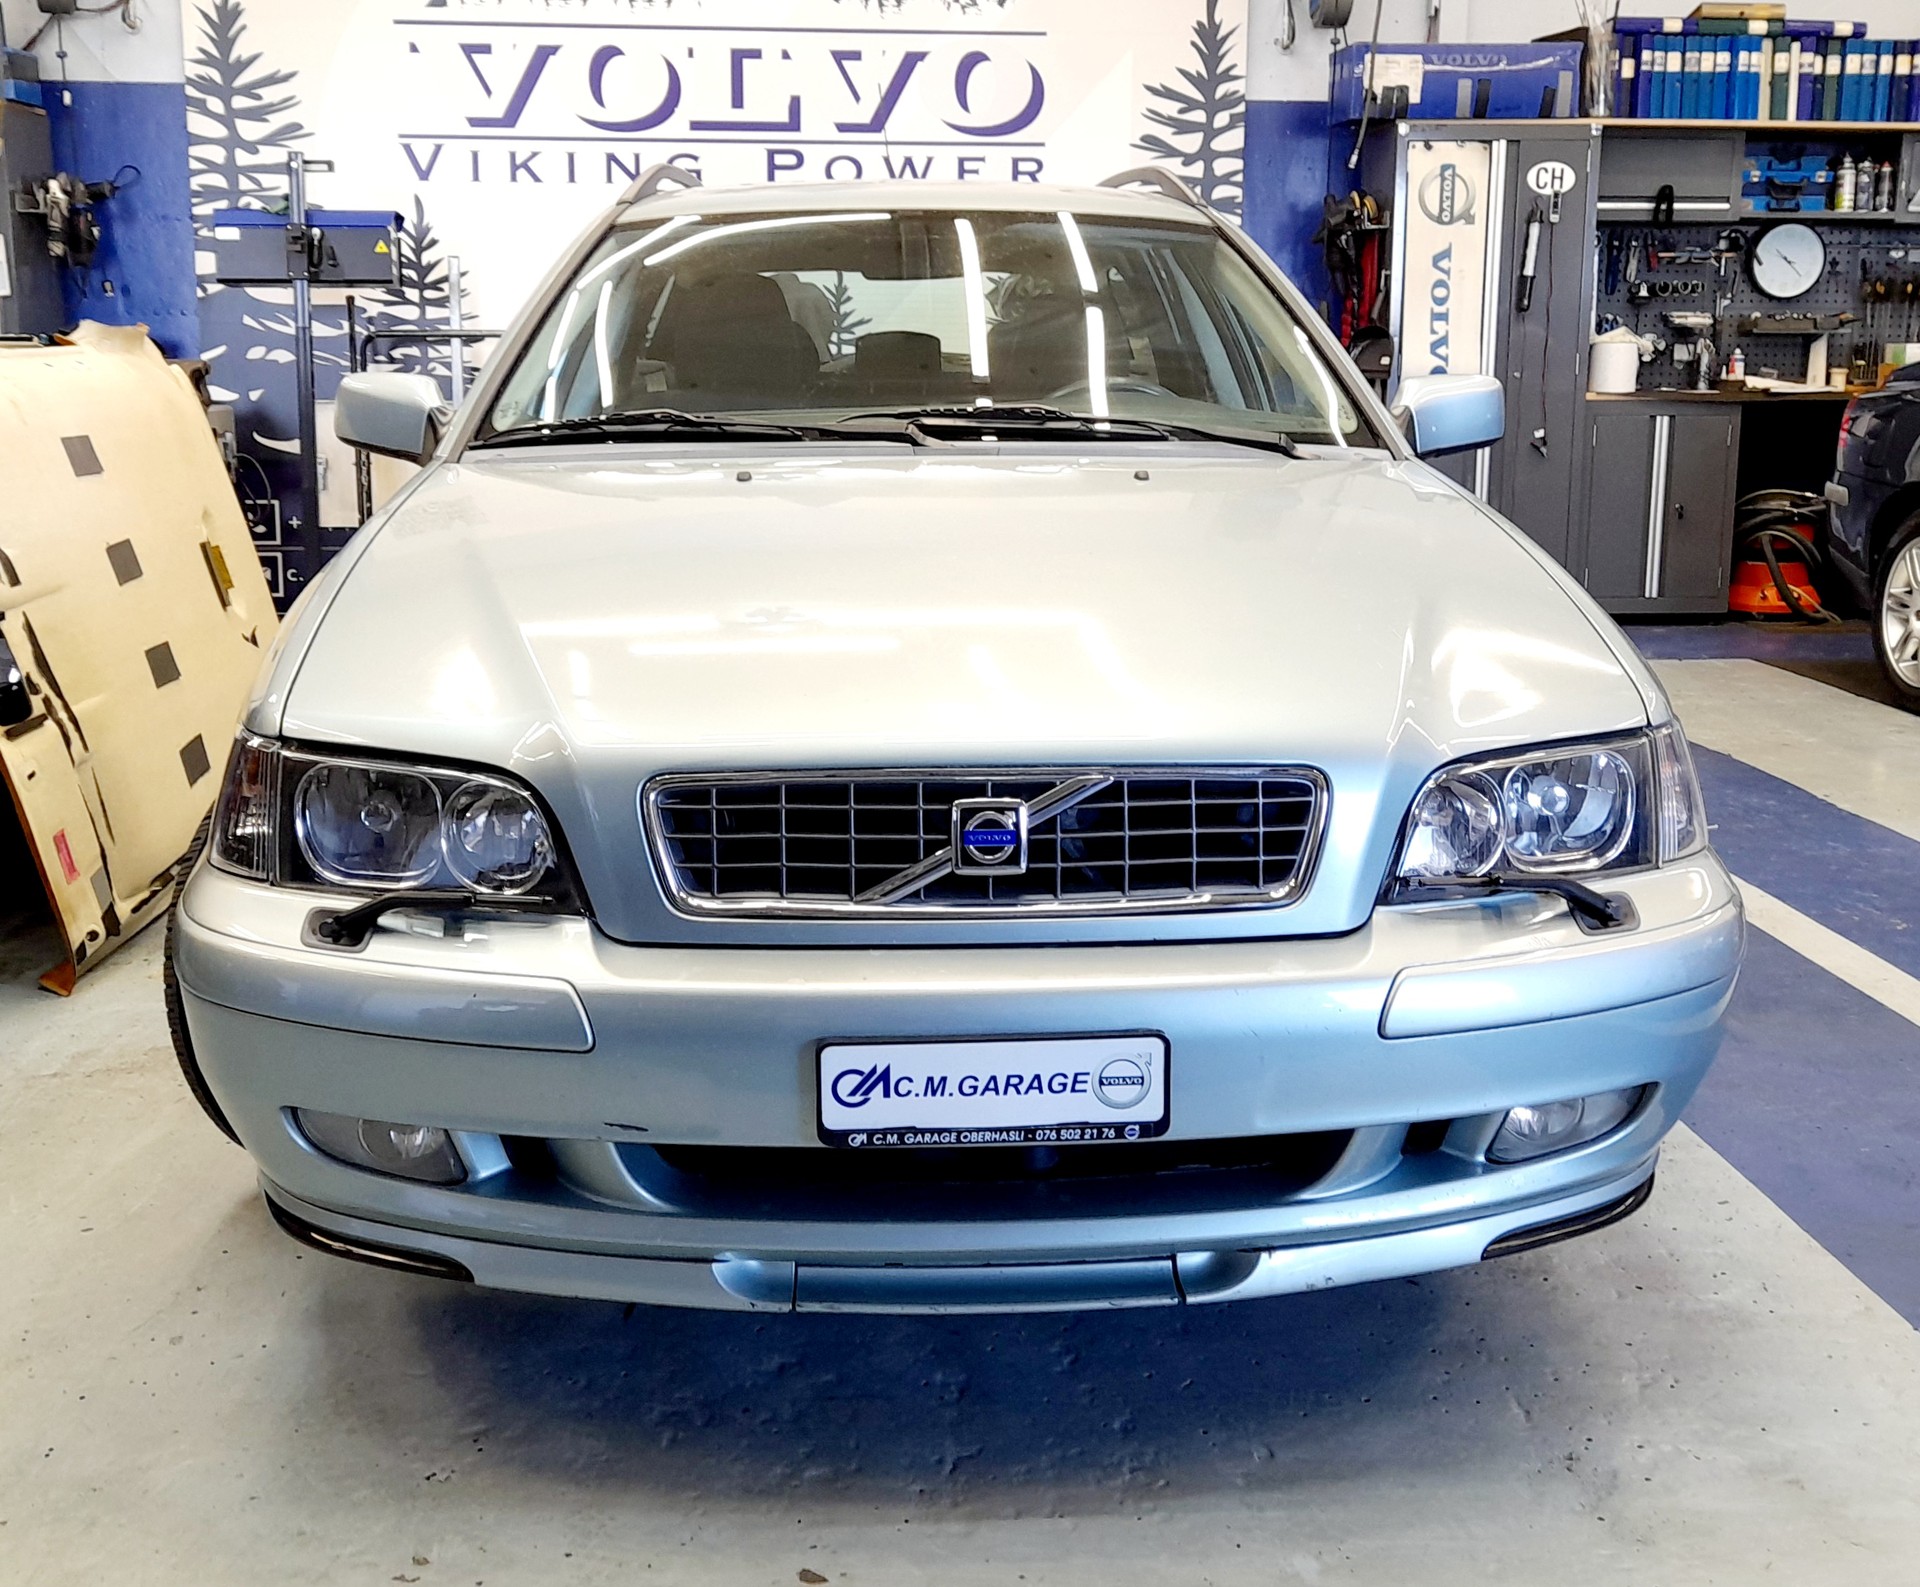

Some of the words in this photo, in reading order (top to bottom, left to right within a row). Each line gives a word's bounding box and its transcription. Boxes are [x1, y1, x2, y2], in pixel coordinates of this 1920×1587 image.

[408, 41, 1045, 137] VOLVO
[400, 142, 703, 184] VIKING
[1535, 167, 1565, 189] CH
[1441, 167, 1454, 223] VOLVO
[968, 834, 1012, 842] VOLVO
[893, 1072, 1090, 1098] C.M.GARAGE
[1101, 1077, 1142, 1085] VOLVO
[873, 1134, 900, 1145] C.M.
[904, 1131, 958, 1144] GARAGE
[960, 1130, 1025, 1143] OBERHASLI
[1035, 1129, 1057, 1141] 076
[1059, 1129, 1082, 1140] 502
[1083, 1128, 1098, 1139] 21
[1101, 1128, 1116, 1138] 76
